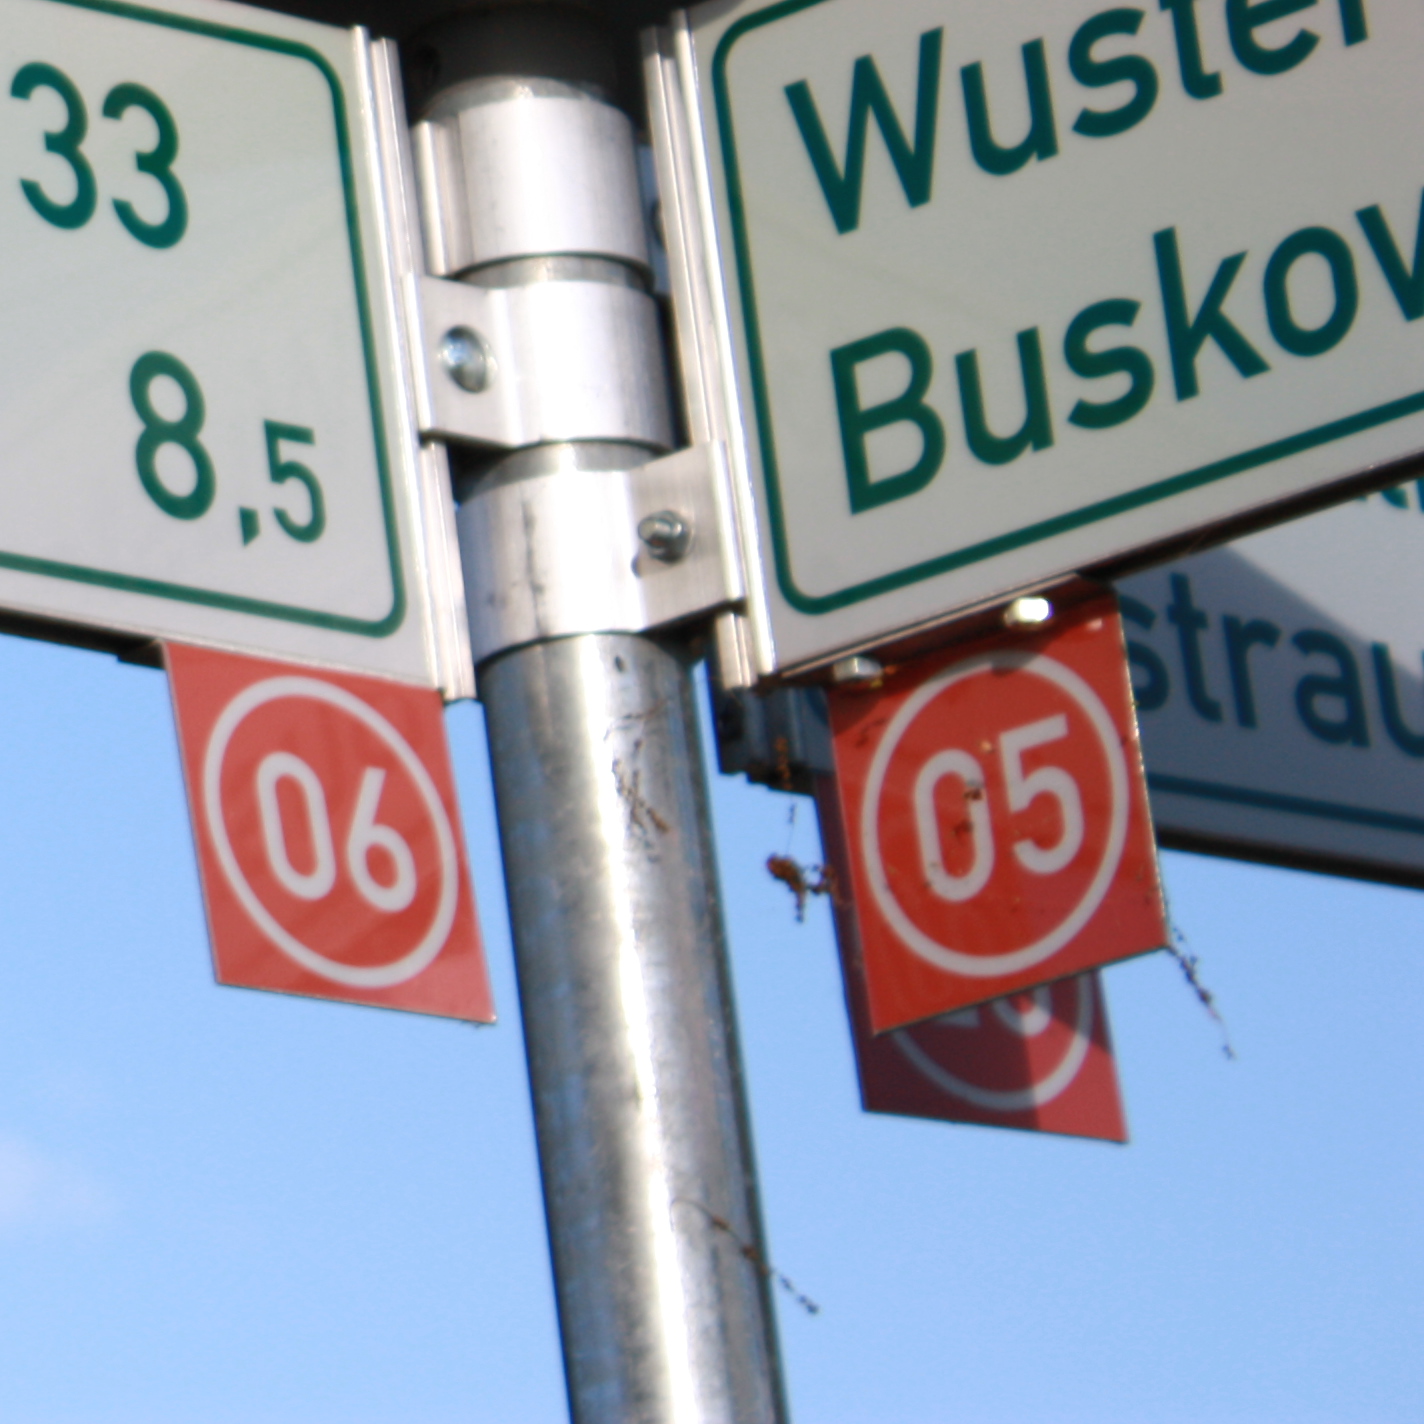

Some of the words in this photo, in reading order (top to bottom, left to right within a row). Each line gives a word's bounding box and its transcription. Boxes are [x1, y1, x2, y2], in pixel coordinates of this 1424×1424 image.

[9, 62, 188, 250] 33
[129, 351, 325, 545] 8,5
[255, 750, 417, 912] 06
[914, 713, 1084, 903] 05
